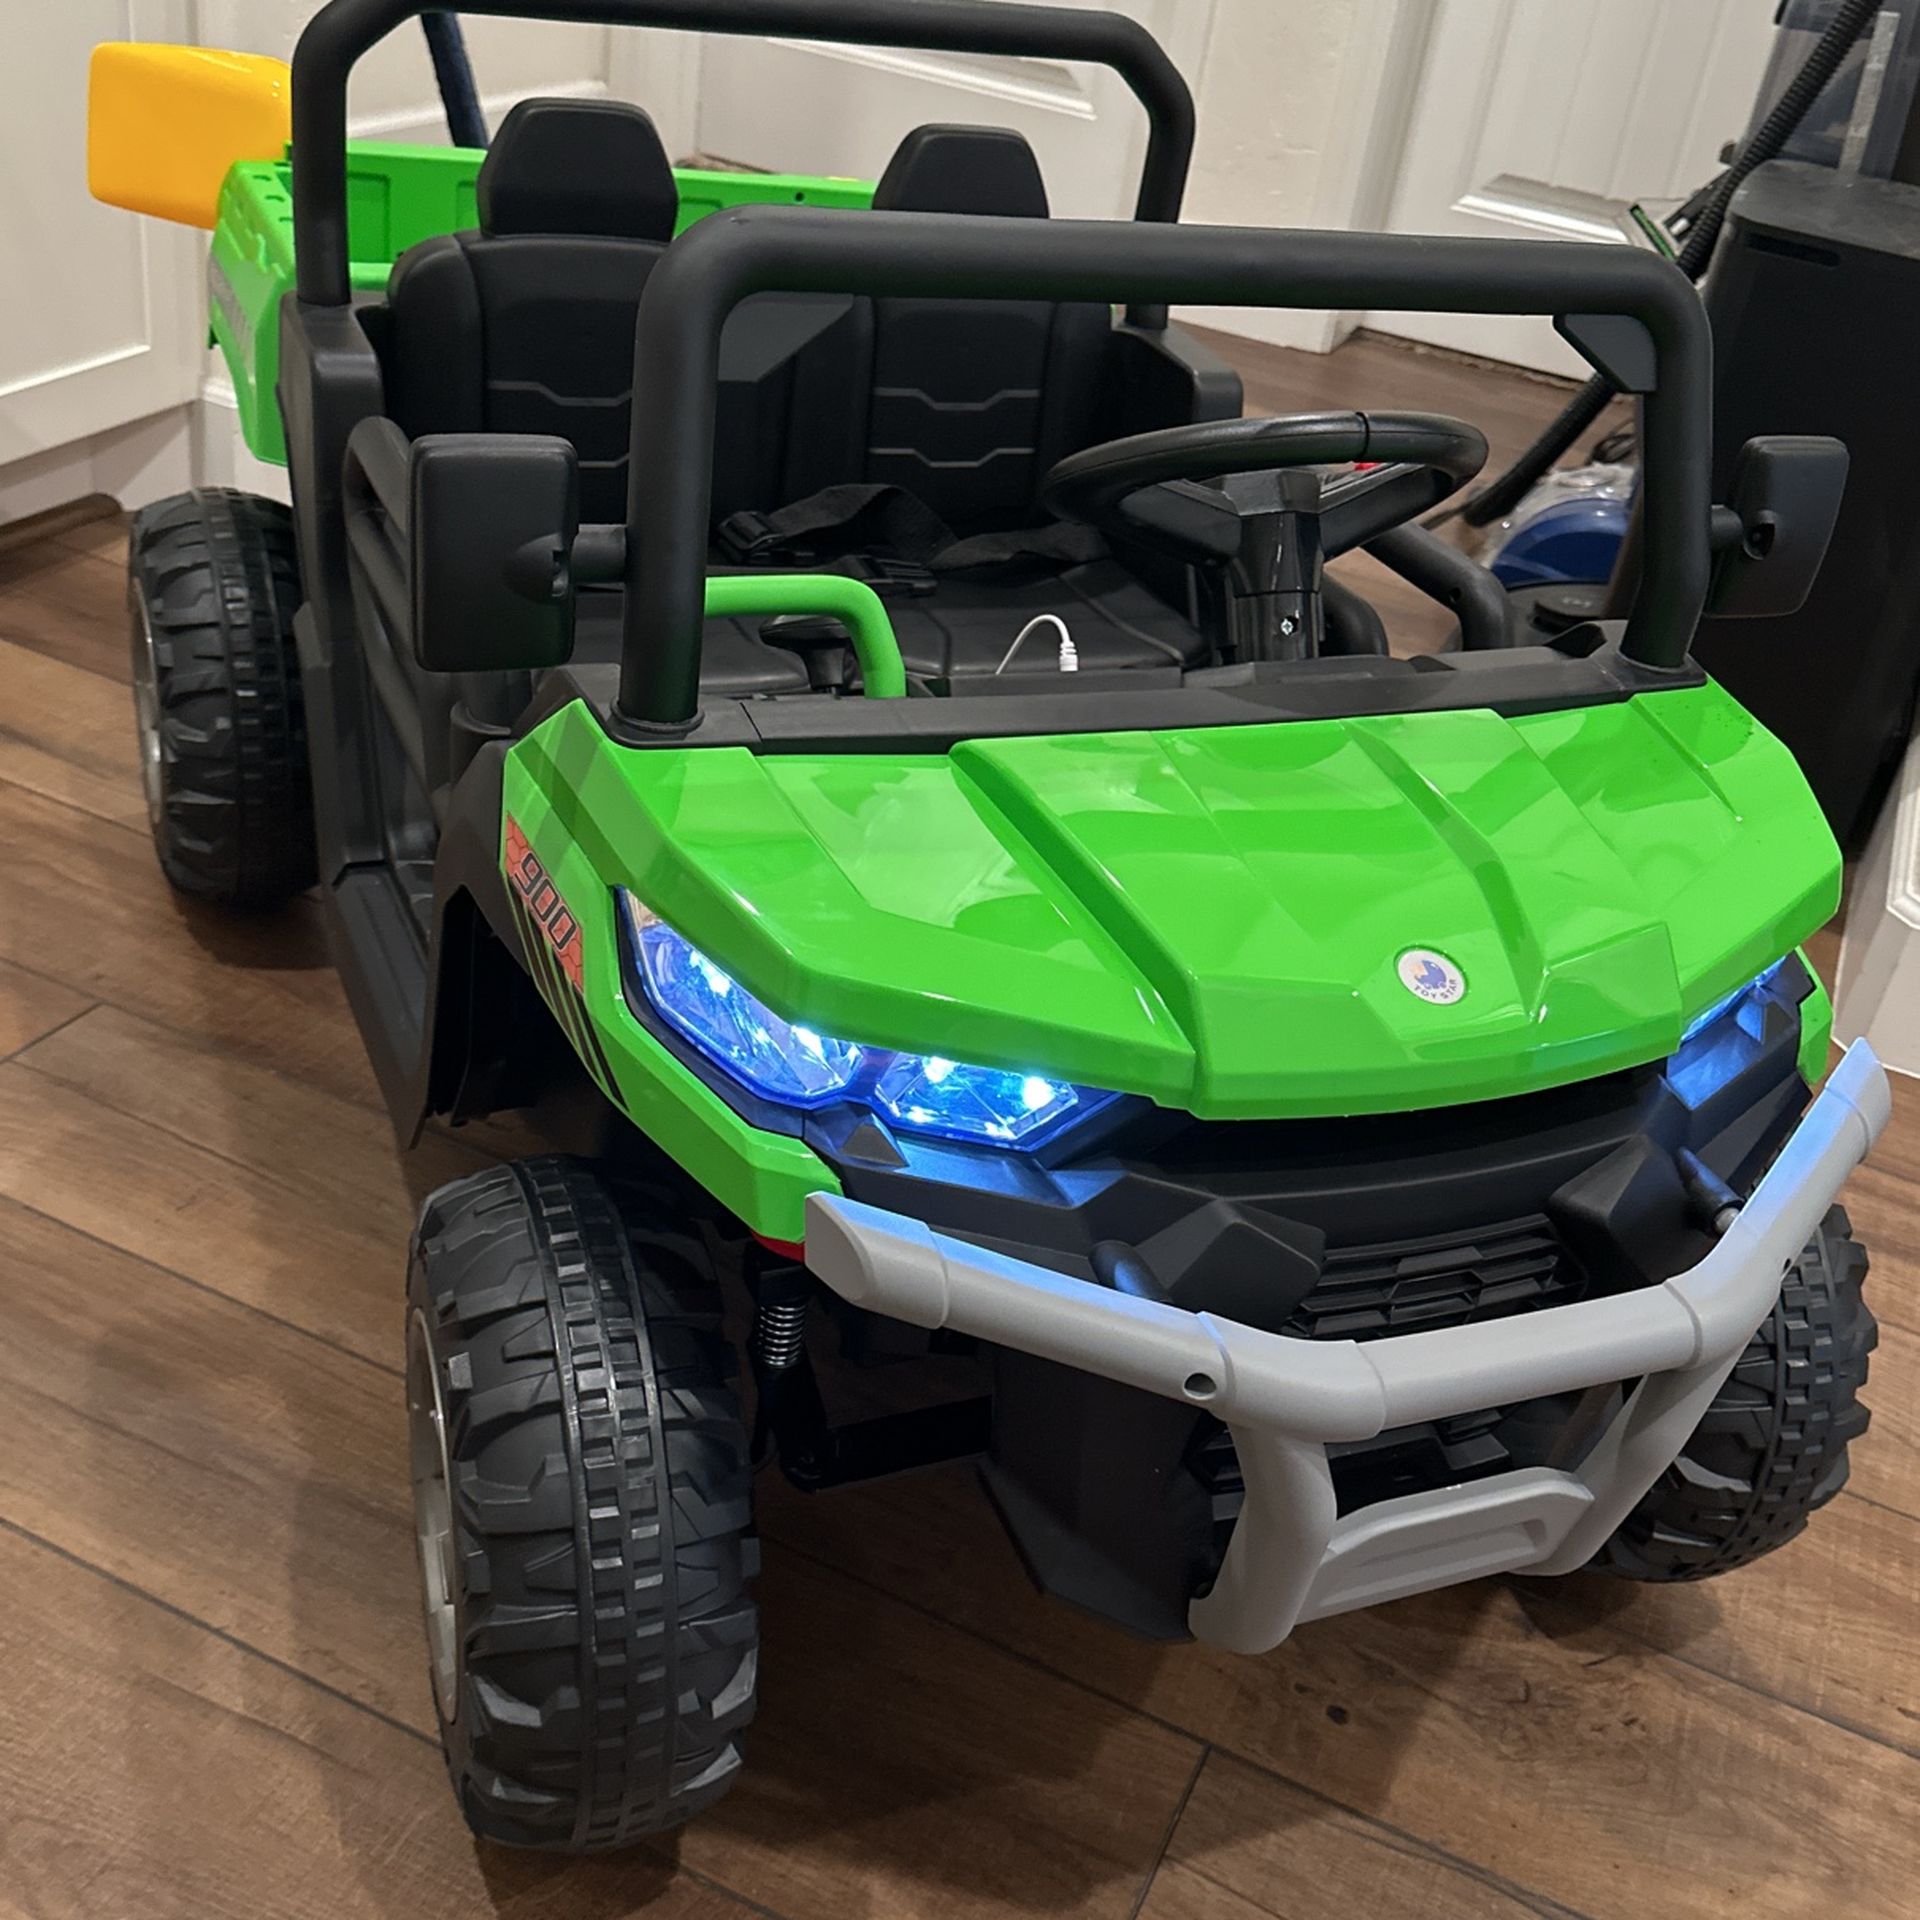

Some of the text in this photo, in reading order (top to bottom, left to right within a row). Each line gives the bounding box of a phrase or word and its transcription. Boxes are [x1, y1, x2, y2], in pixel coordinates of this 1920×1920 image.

[513, 852, 577, 951] 900
[1414, 979, 1457, 999] TOY STAR
